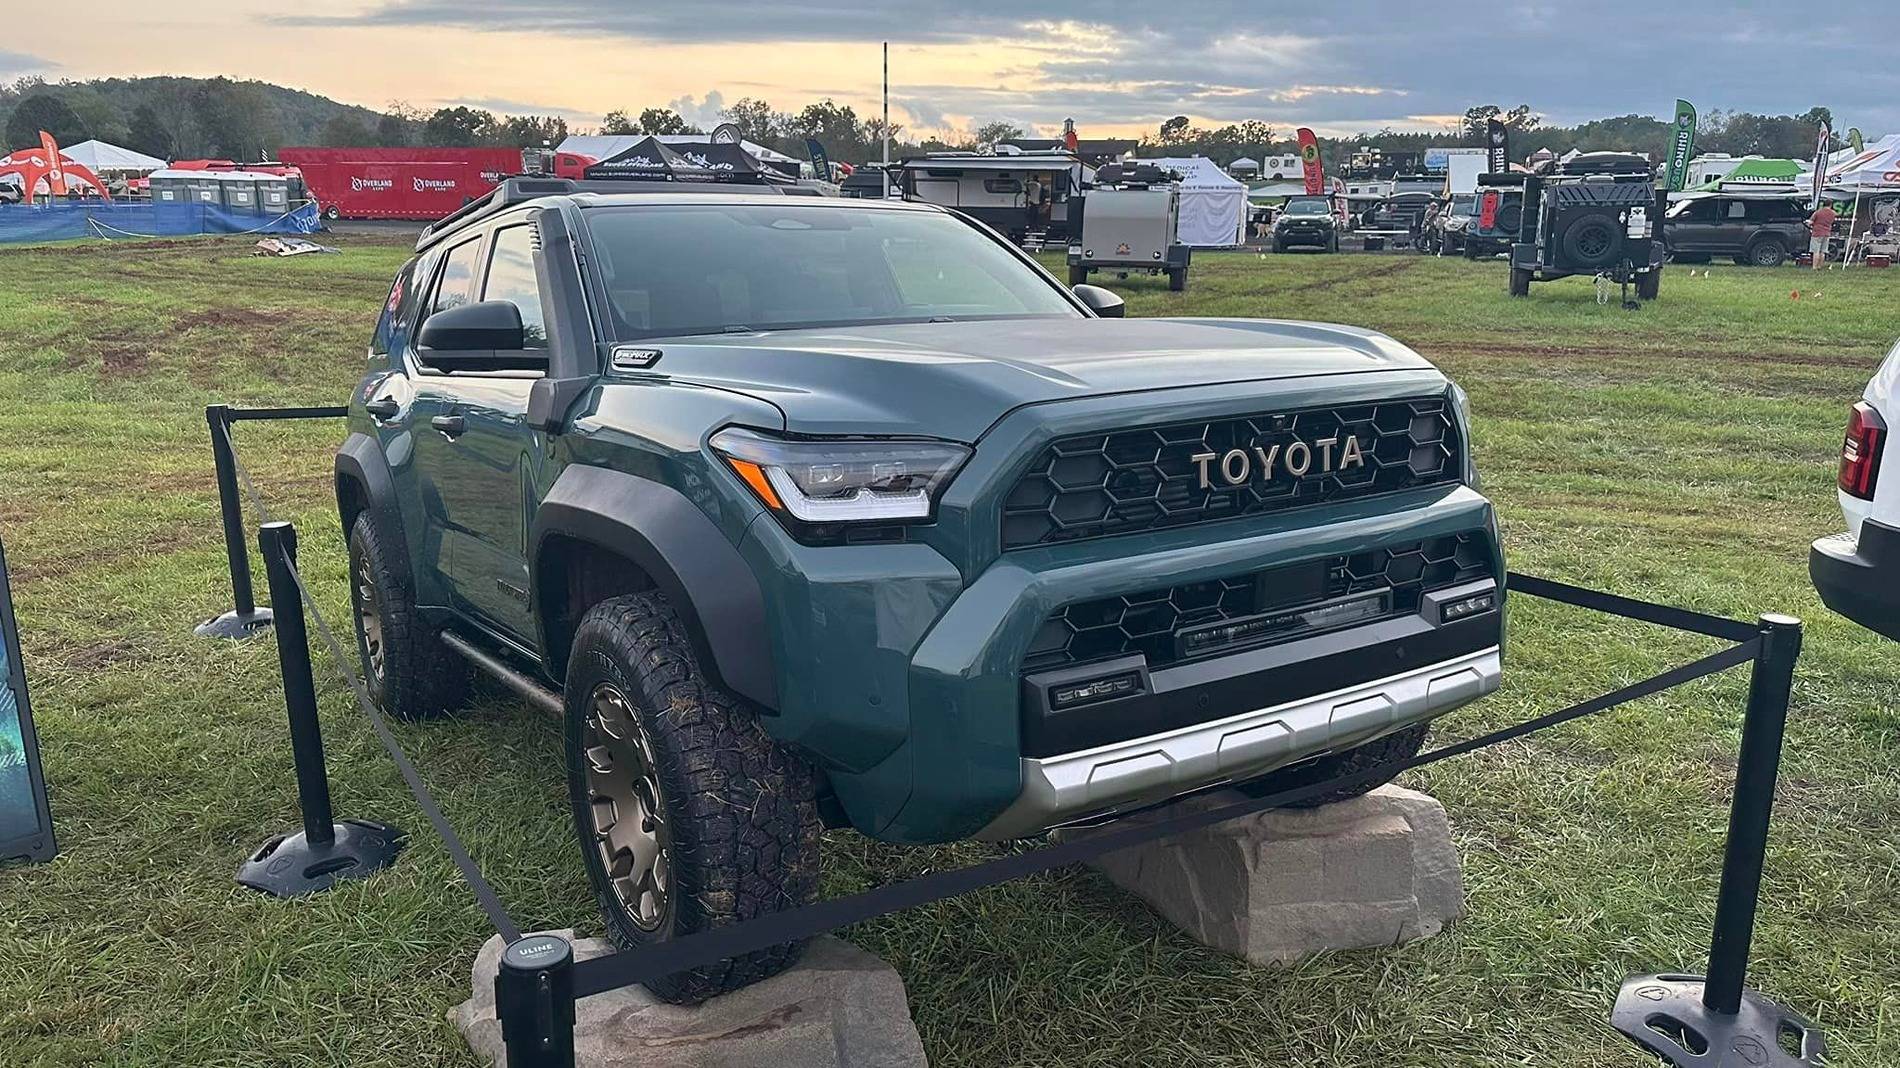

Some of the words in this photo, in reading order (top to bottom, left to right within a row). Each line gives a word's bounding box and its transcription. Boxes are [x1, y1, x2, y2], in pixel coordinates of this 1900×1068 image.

[363, 179, 393, 187] OVERLAND
[424, 179, 456, 188] OVERLAND
[1192, 435, 1364, 489] TOYOTA
[520, 944, 553, 955] ULINE
